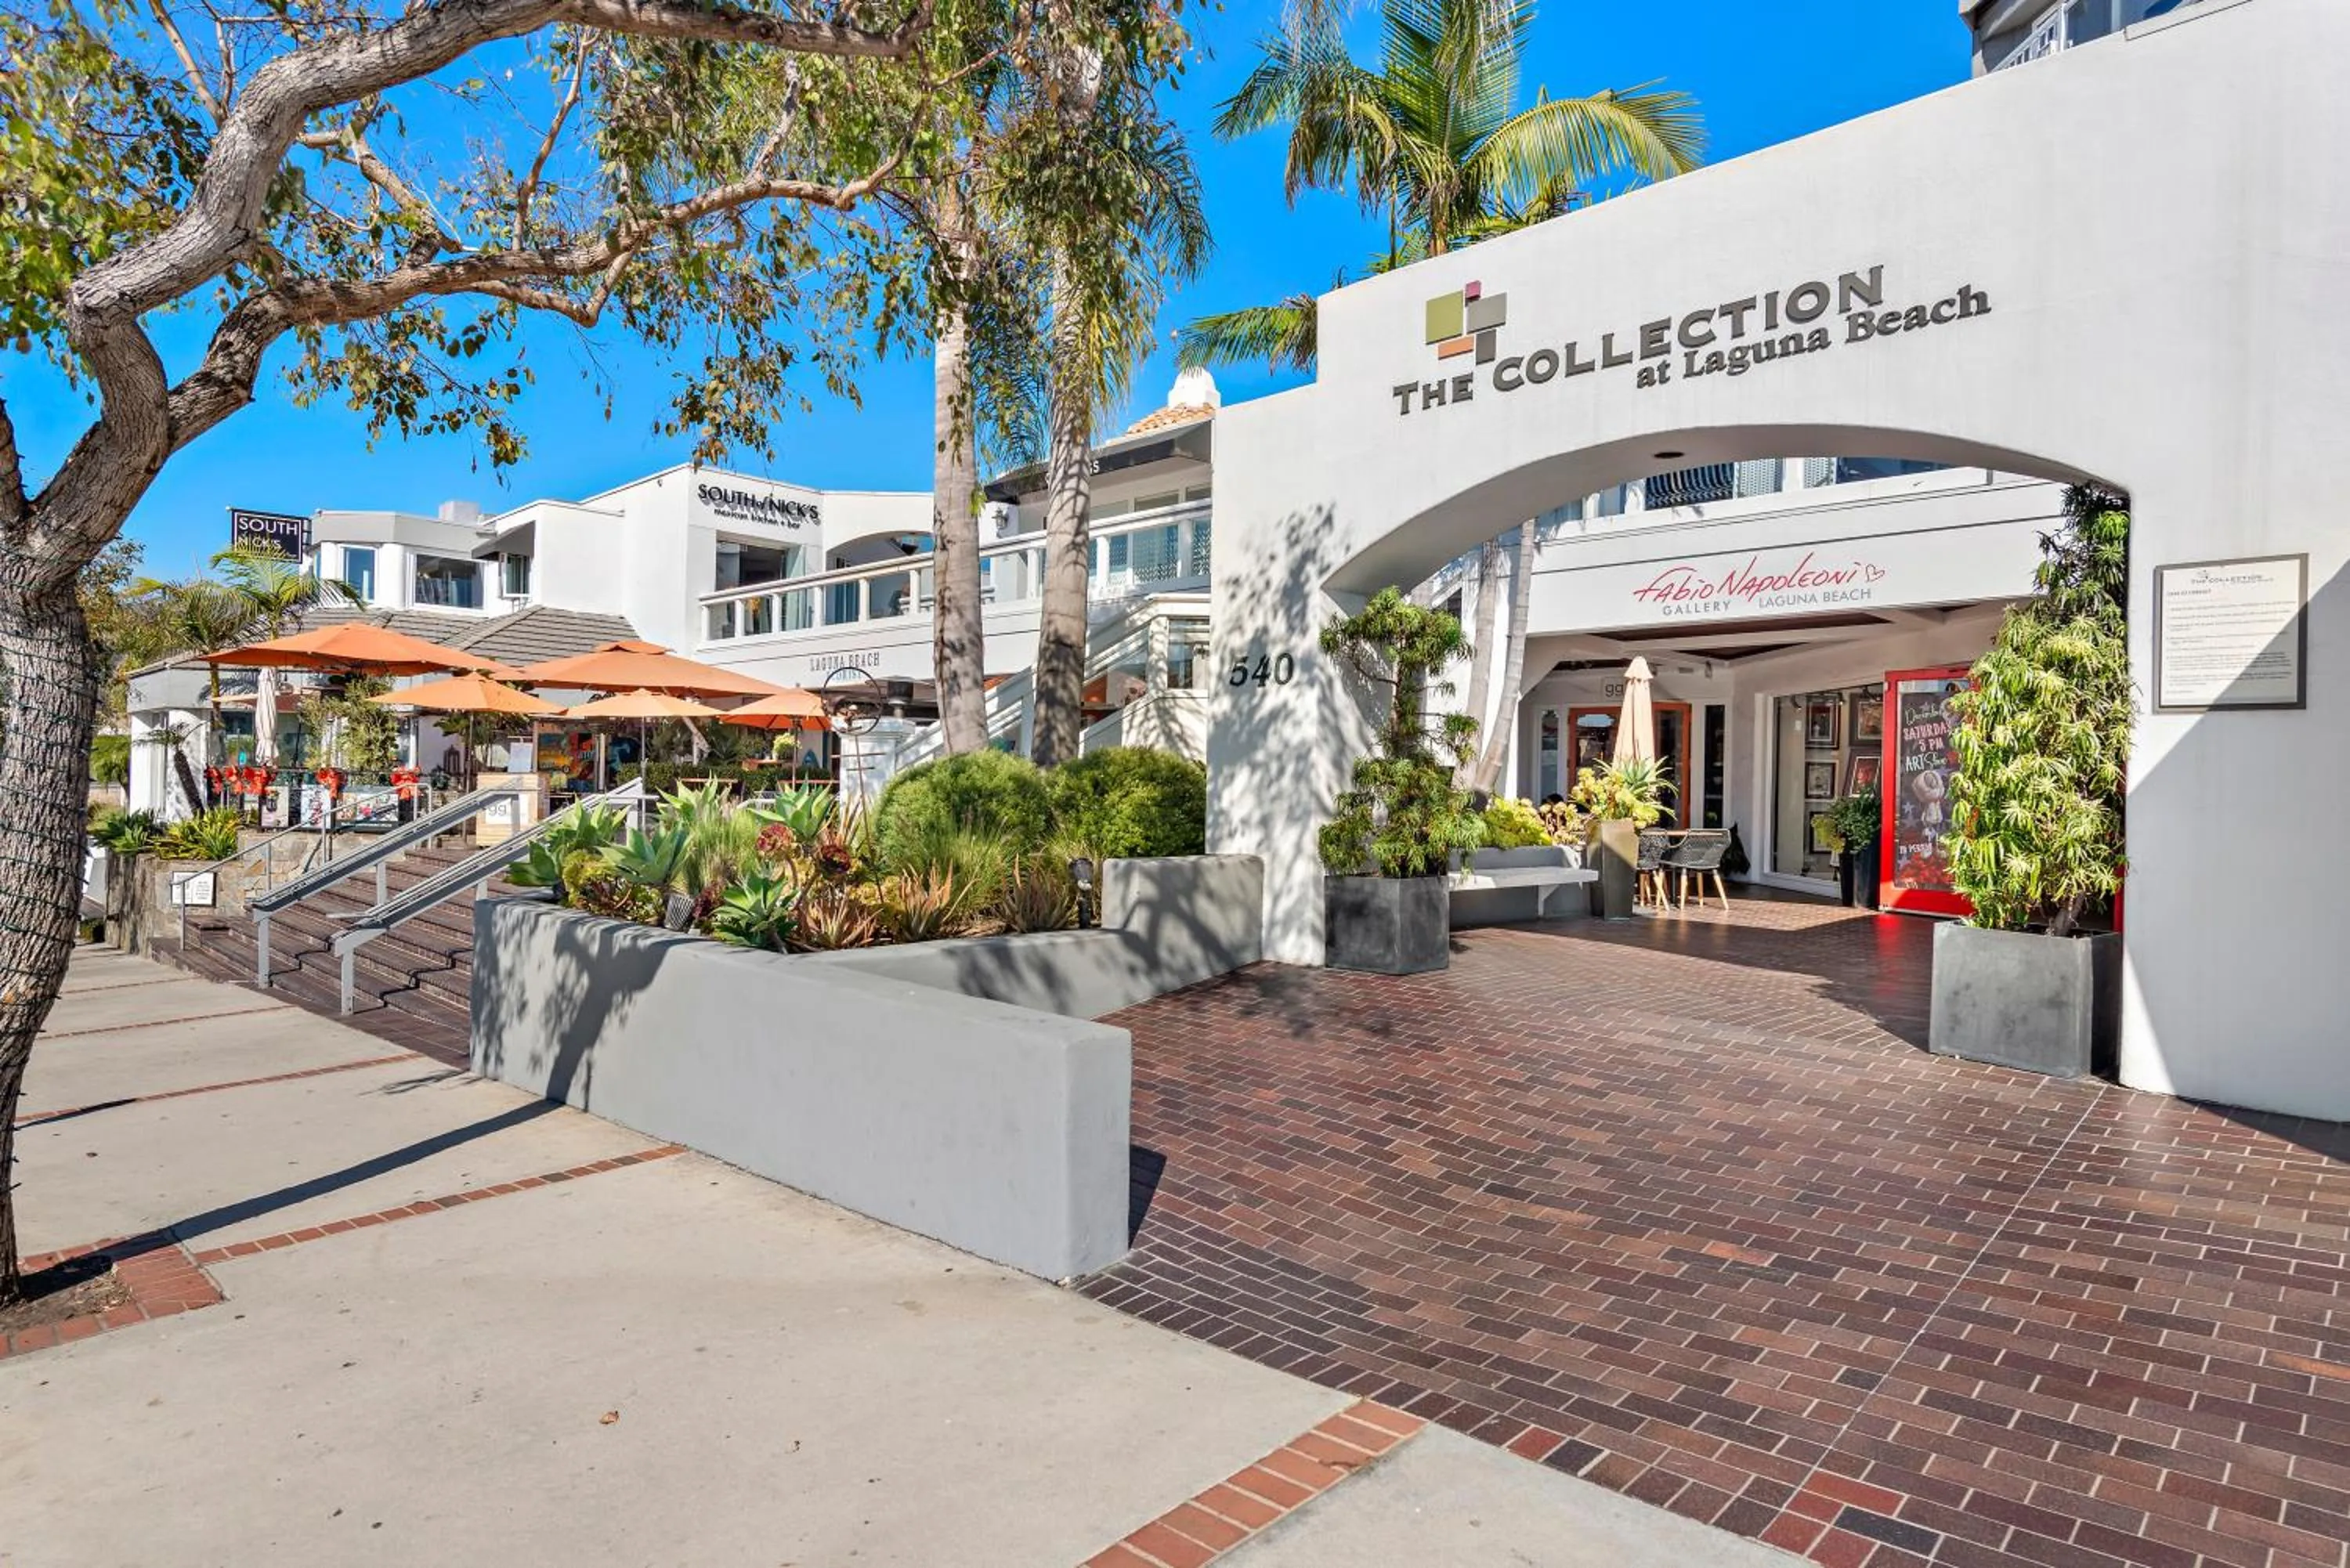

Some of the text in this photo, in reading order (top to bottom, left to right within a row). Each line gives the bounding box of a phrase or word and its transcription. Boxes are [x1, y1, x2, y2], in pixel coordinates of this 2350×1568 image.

[1393, 265, 1884, 416] THE COLLECTION
[1636, 284, 1993, 389] at Laguna Beach
[696, 483, 757, 509] SOUTH
[768, 498, 819, 519] NICK'S
[238, 517, 298, 536] SOUTH
[1662, 588, 1871, 616] GALLERY LAGUNA BEACH
[809, 652, 880, 671] LAGUNA BEACH
[1229, 652, 1295, 688] 540
[1918, 737, 1944, 752] 5 PM
[1905, 753, 1925, 771] ART
